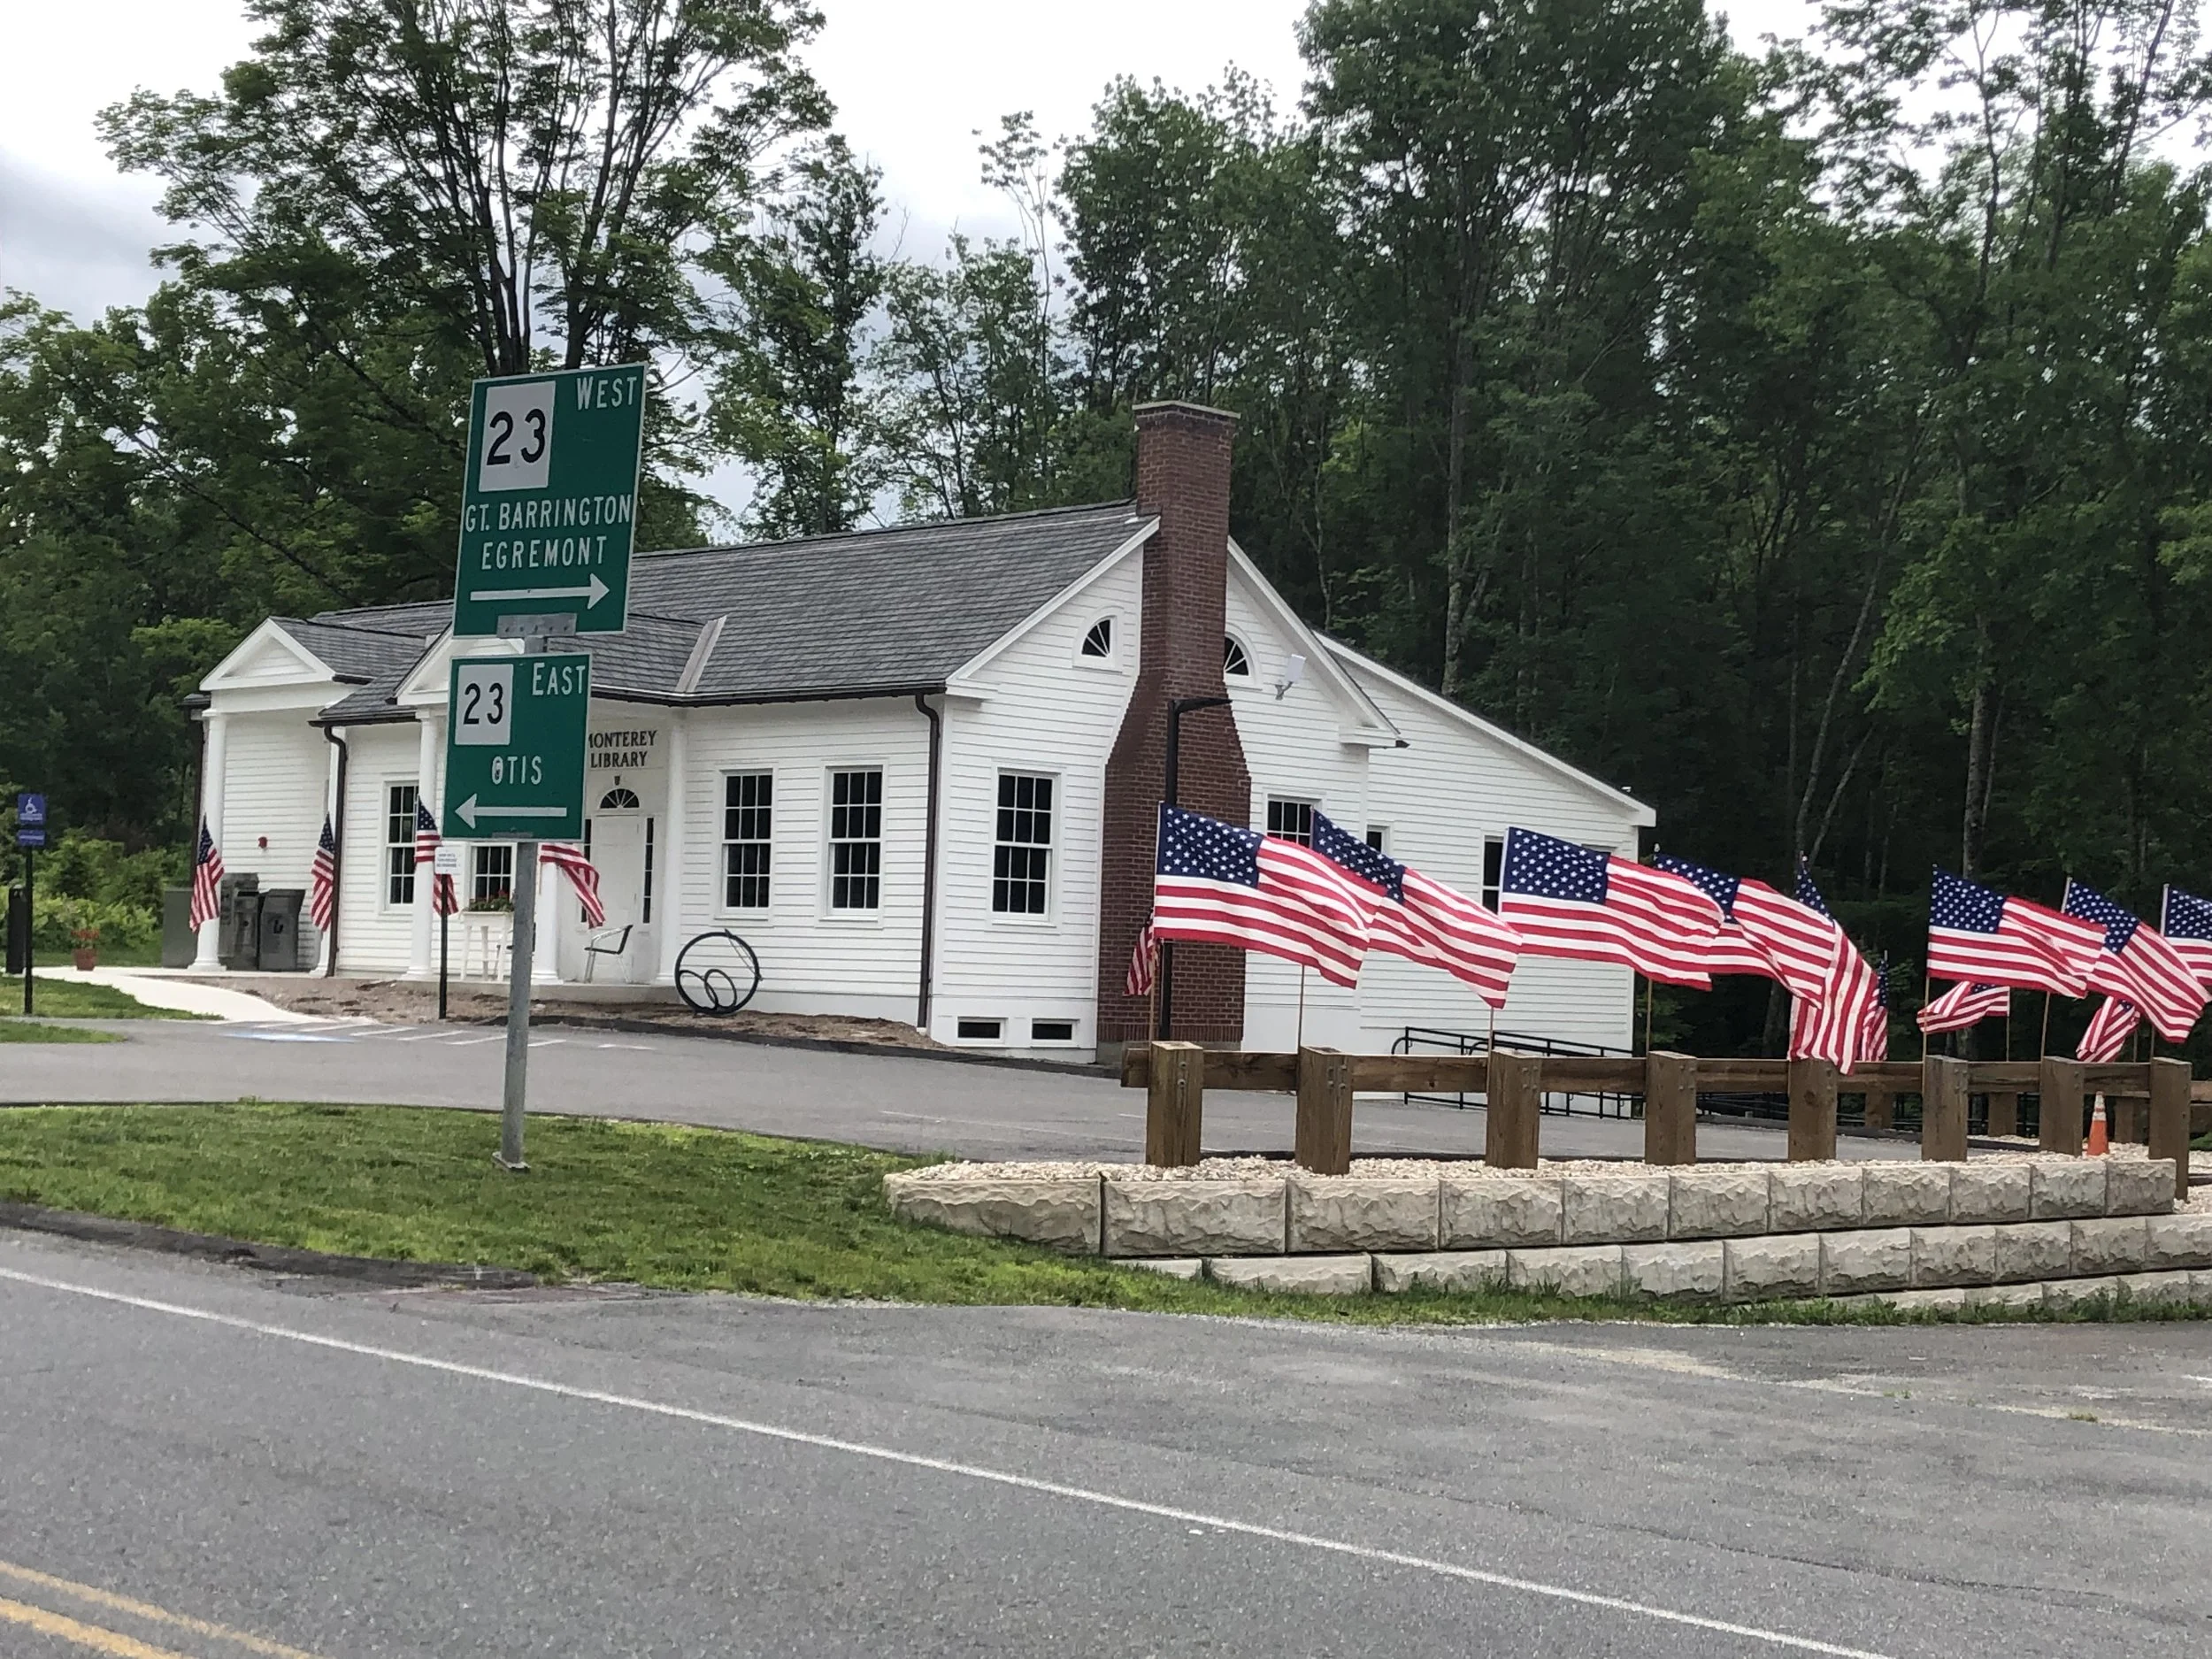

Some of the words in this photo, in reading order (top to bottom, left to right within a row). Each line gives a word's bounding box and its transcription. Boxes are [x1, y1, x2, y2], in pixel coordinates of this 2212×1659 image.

[576, 376, 637, 411] WEST
[487, 409, 546, 465] 23
[465, 503, 490, 533] GT.
[498, 494, 632, 531] BARRINGTON
[481, 535, 607, 570] EGREMONT
[532, 662, 586, 695] EAST
[463, 683, 503, 725] 23
[492, 756, 542, 785] OTIS
[590, 751, 648, 768] LIBRARY
